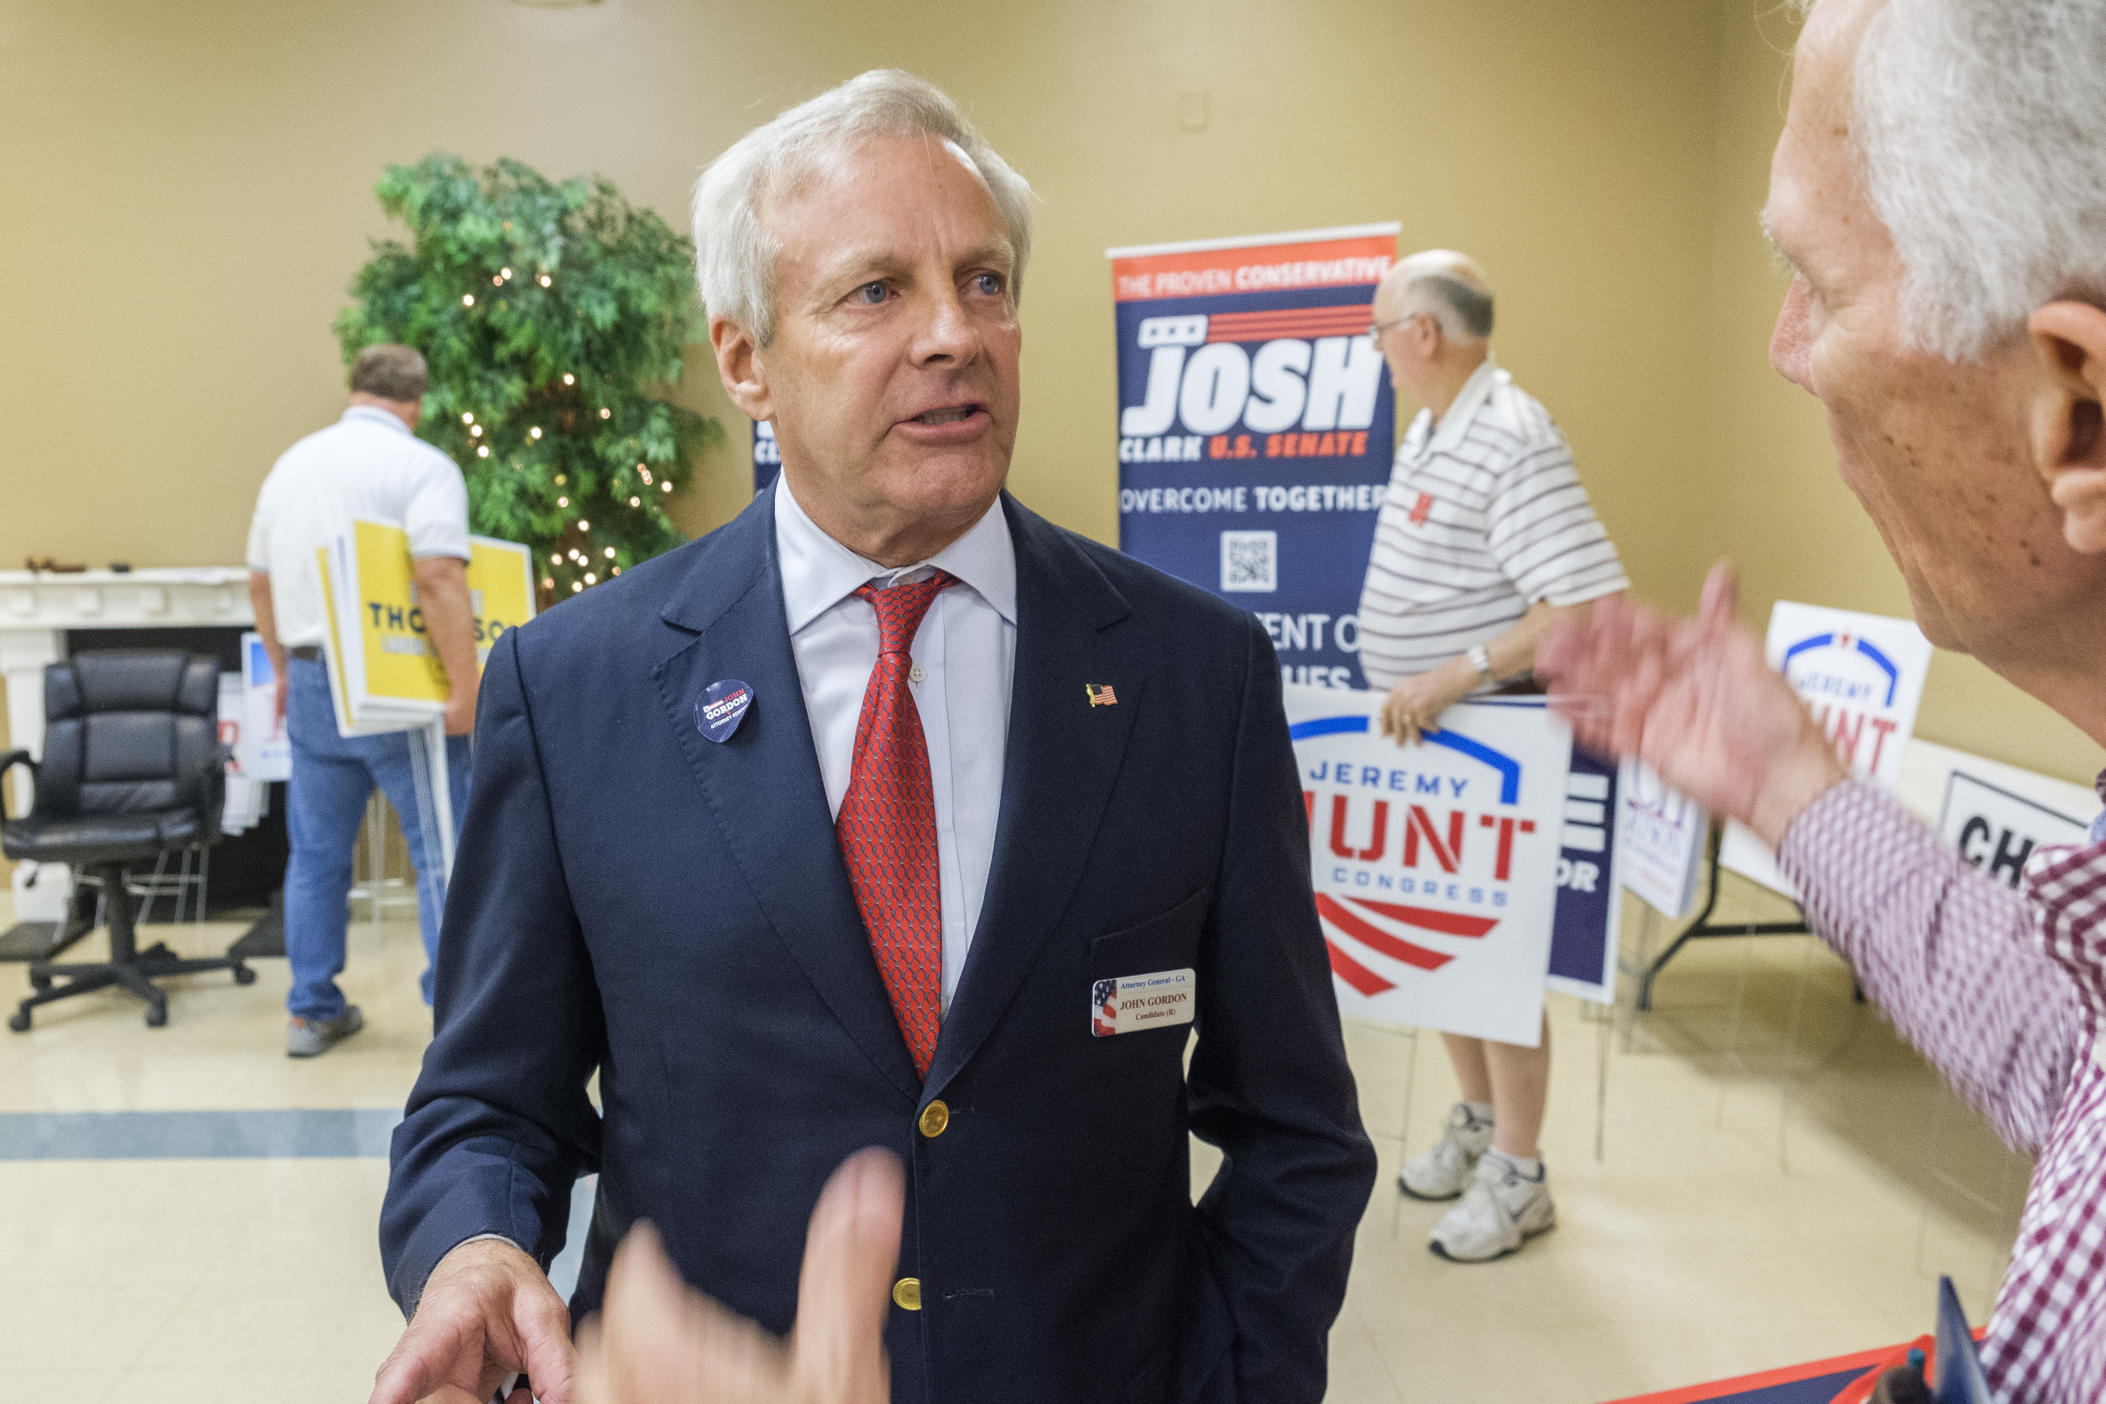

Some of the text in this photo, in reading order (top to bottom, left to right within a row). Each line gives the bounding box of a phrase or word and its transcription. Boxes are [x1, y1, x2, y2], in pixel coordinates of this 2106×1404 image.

[1118, 275, 1150, 297] THE
[1155, 268, 1232, 293] PROVEN
[1121, 318, 1384, 437] JOSH
[1118, 432, 1369, 463] CLARK U.S. SENATE
[1120, 487, 1248, 513] OVERCOME
[706, 693, 748, 720] GORDON
[1309, 761, 1470, 799] JEREMY
[1333, 867, 1509, 908] CONGRESS
[1120, 982, 1146, 990] Attorney
[1147, 976, 1171, 986] General
[1175, 975, 1186, 983] GA
[1119, 992, 1189, 1011] JOHN GORDON
[1135, 1008, 1177, 1021] Candidate (R)
